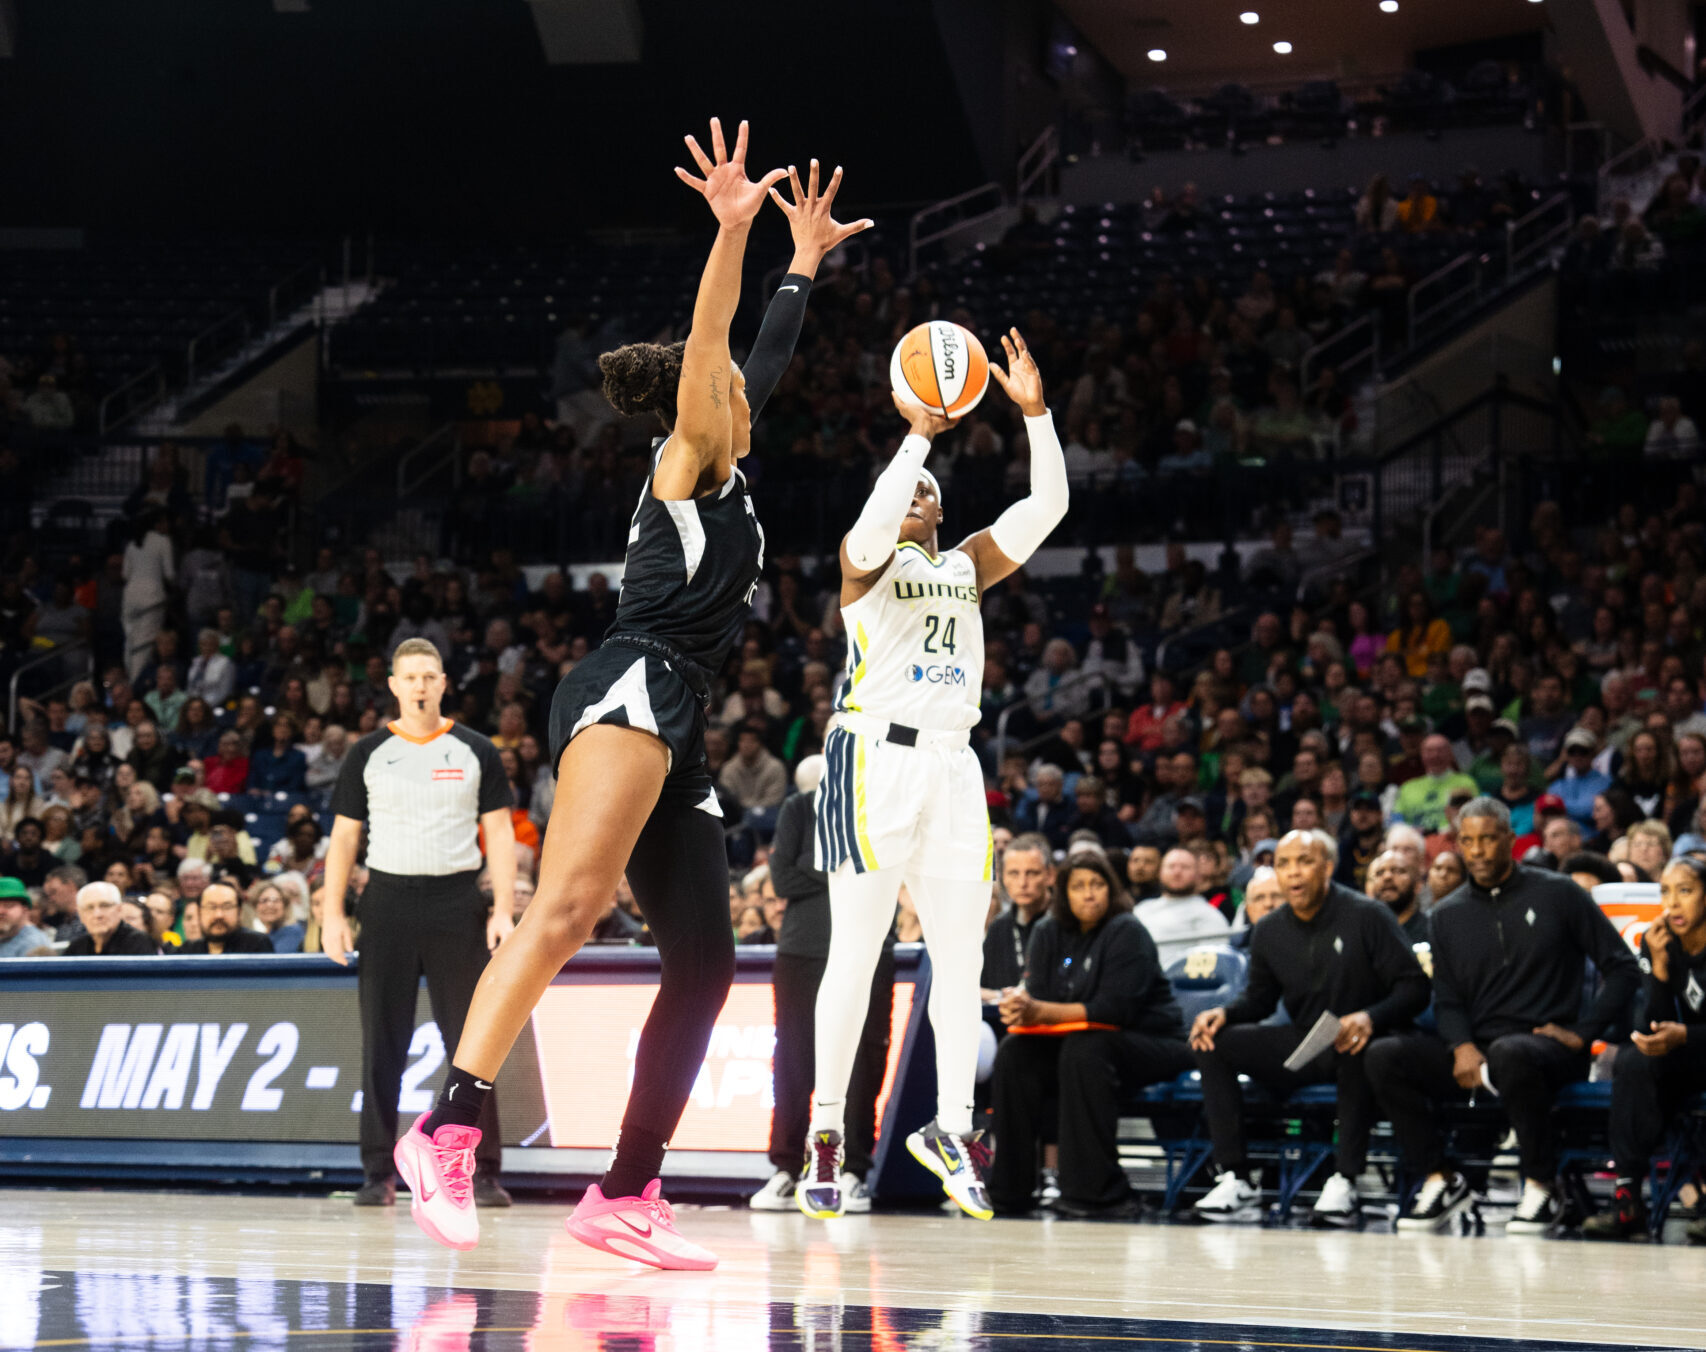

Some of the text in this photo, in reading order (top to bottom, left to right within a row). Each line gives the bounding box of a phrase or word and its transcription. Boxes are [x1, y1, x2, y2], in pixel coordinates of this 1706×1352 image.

[923, 614, 957, 656] 24
[925, 665, 967, 688] GEM
[79, 1022, 248, 1110] MAY
[240, 1021, 300, 1111] 2
